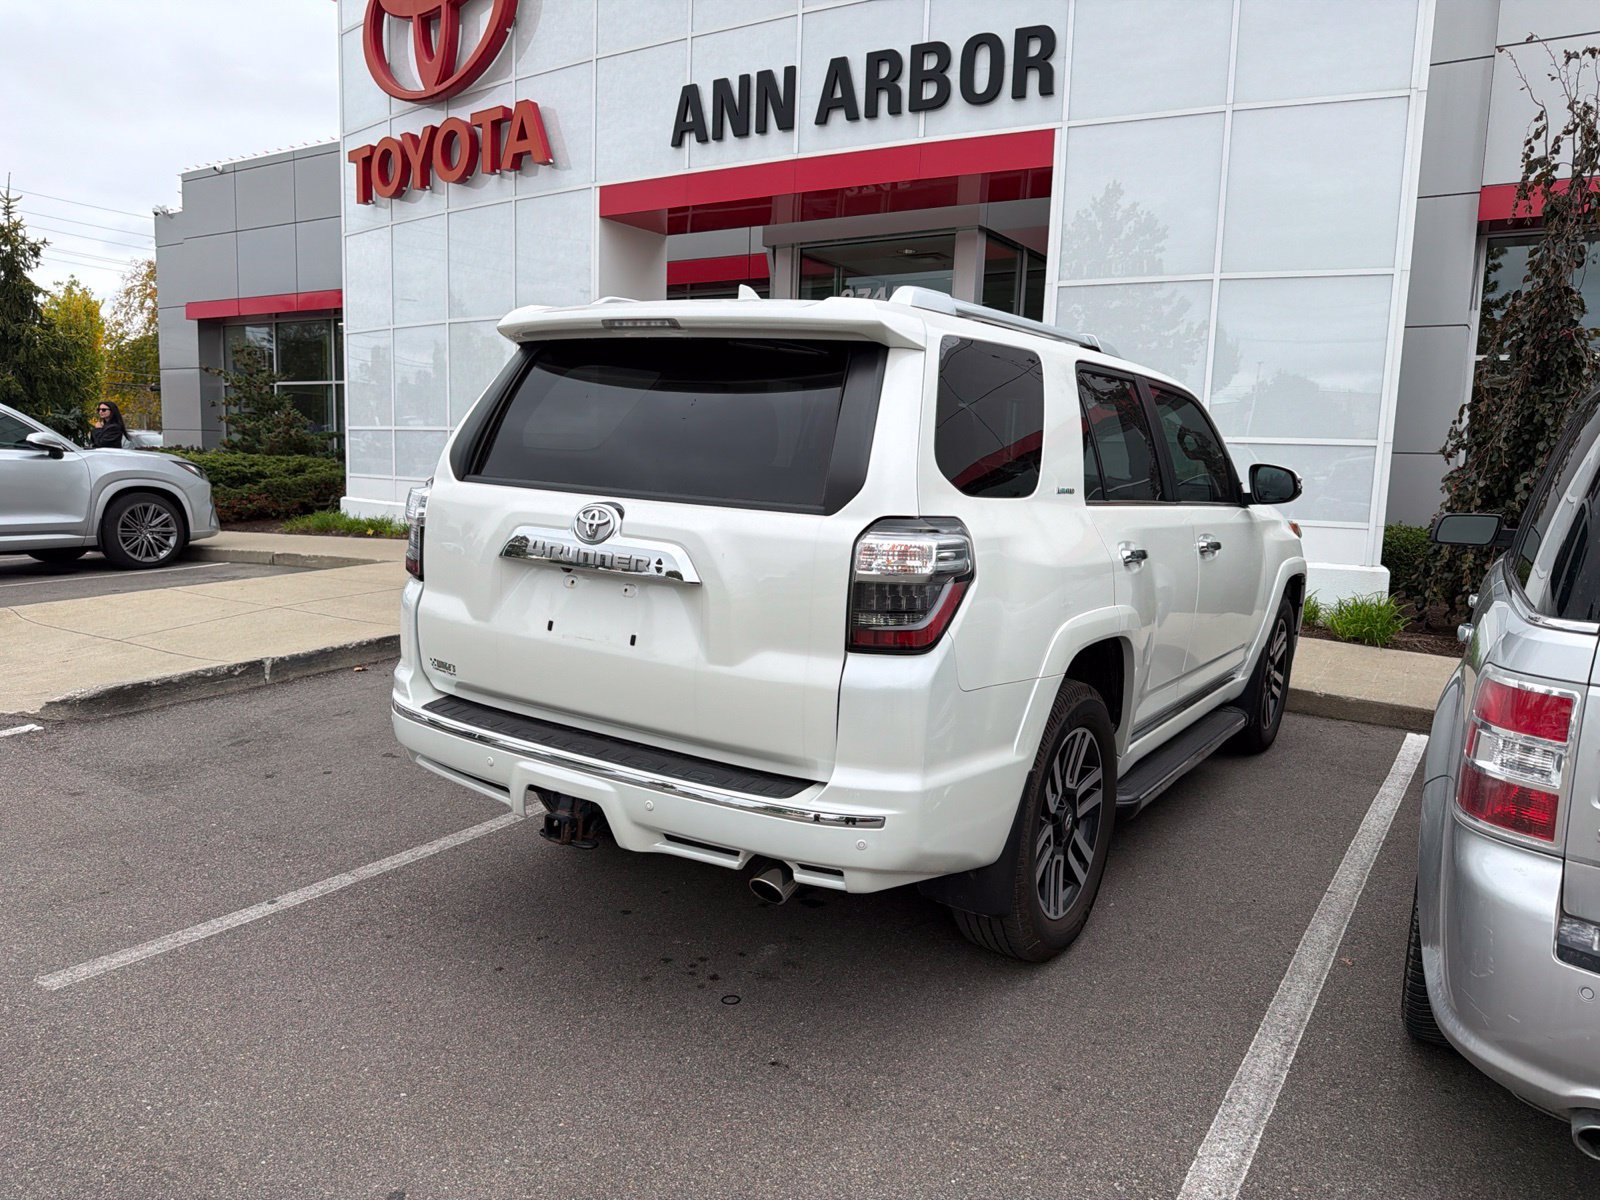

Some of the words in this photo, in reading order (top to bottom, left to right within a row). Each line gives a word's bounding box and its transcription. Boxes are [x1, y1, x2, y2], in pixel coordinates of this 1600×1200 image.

[671, 66, 797, 148] ANN
[815, 24, 1056, 126] ARBOR
[348, 99, 554, 205] TOYOTA
[525, 539, 652, 572] 4RUNNER
